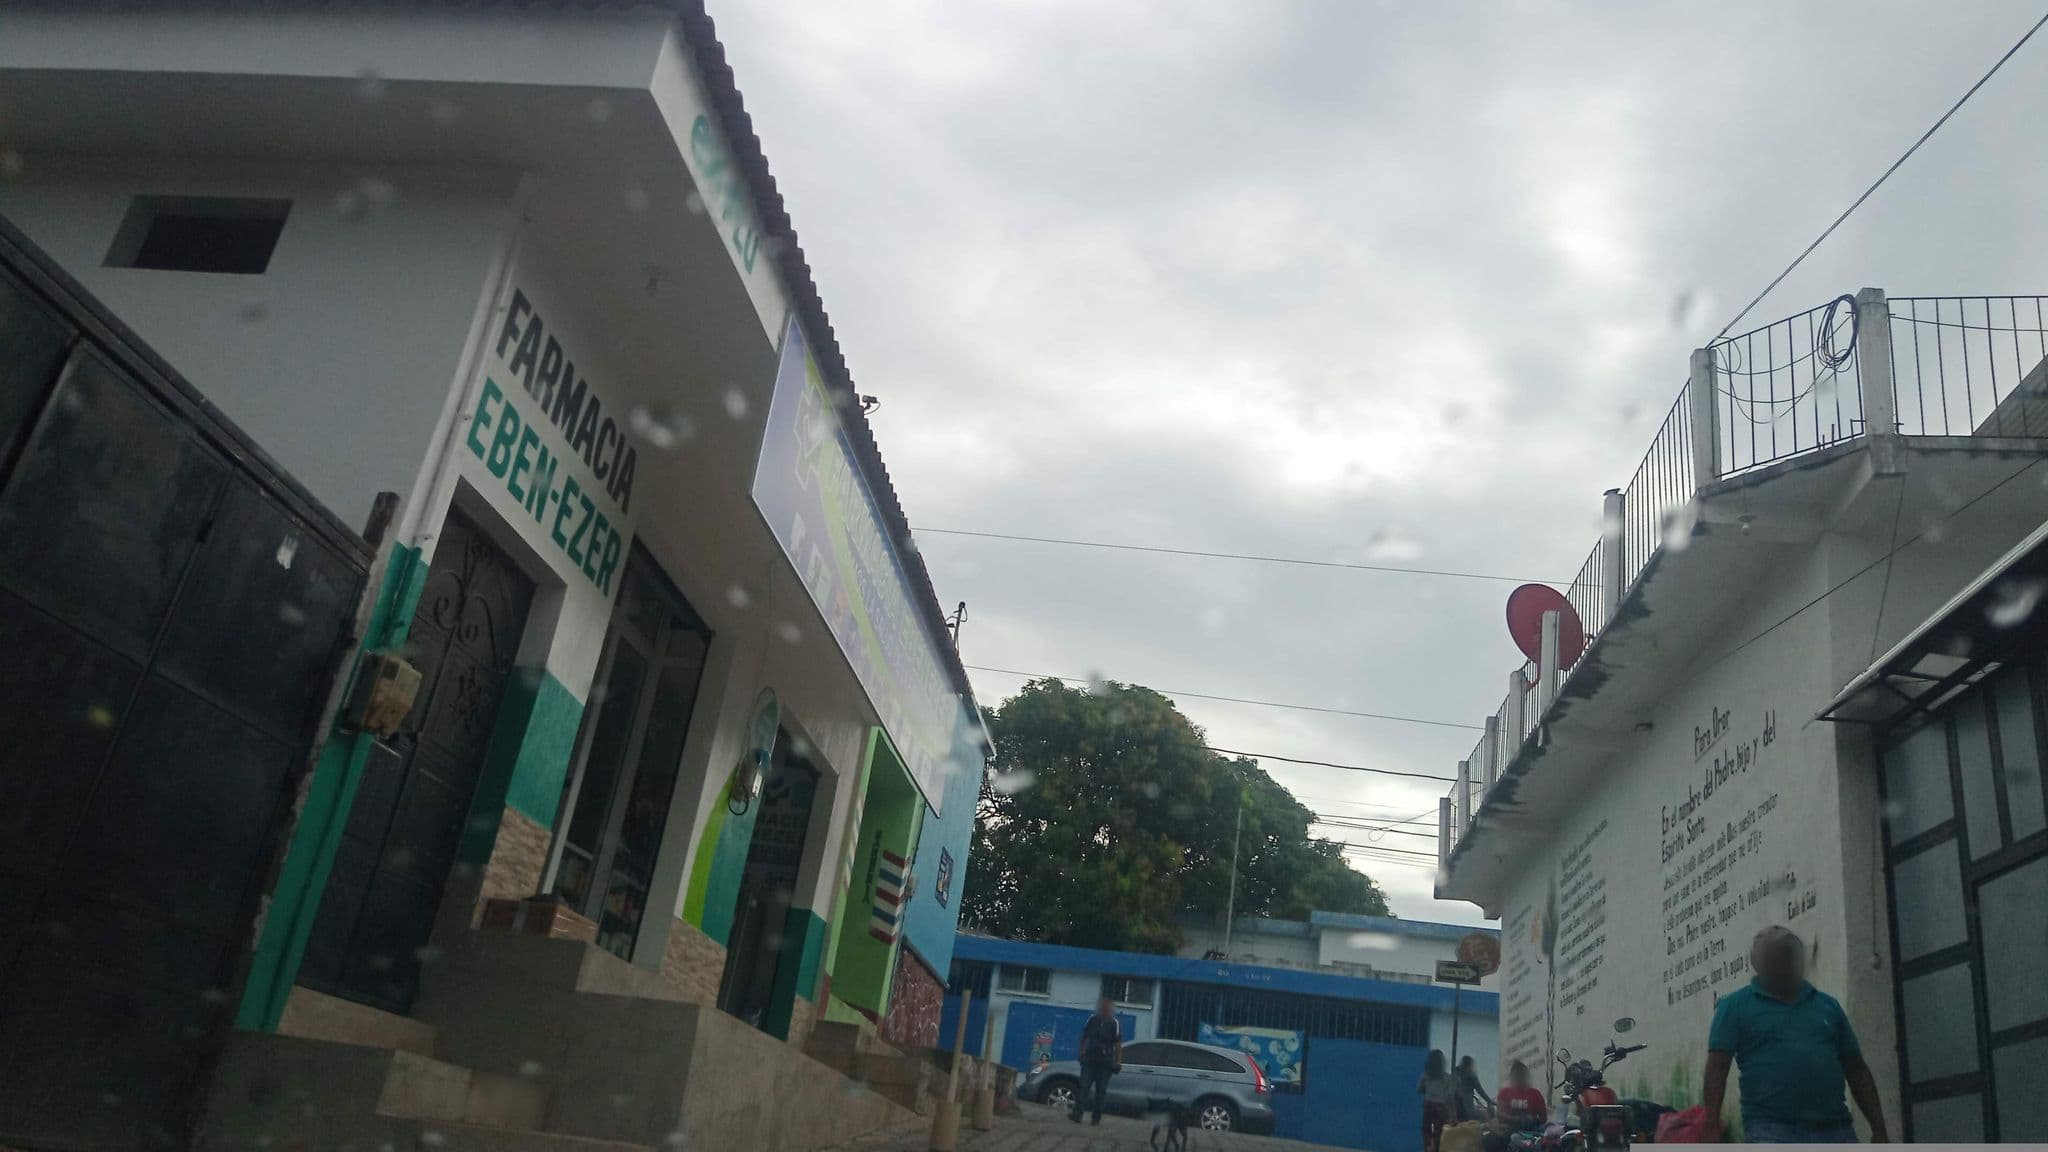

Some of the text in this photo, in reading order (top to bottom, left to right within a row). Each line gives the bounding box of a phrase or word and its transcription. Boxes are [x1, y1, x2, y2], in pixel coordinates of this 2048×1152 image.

[496, 288, 637, 514] FARMACIA
[467, 376, 622, 597] EBEN-EZER
[1661, 805, 1669, 835] En
[1671, 805, 1676, 828] el
[1678, 784, 1700, 820] nombre
[1703, 769, 1712, 799] del
[1762, 709, 1775, 747] del
[1694, 706, 1730, 755] Para Orar
[1686, 816, 1704, 844] Santo
